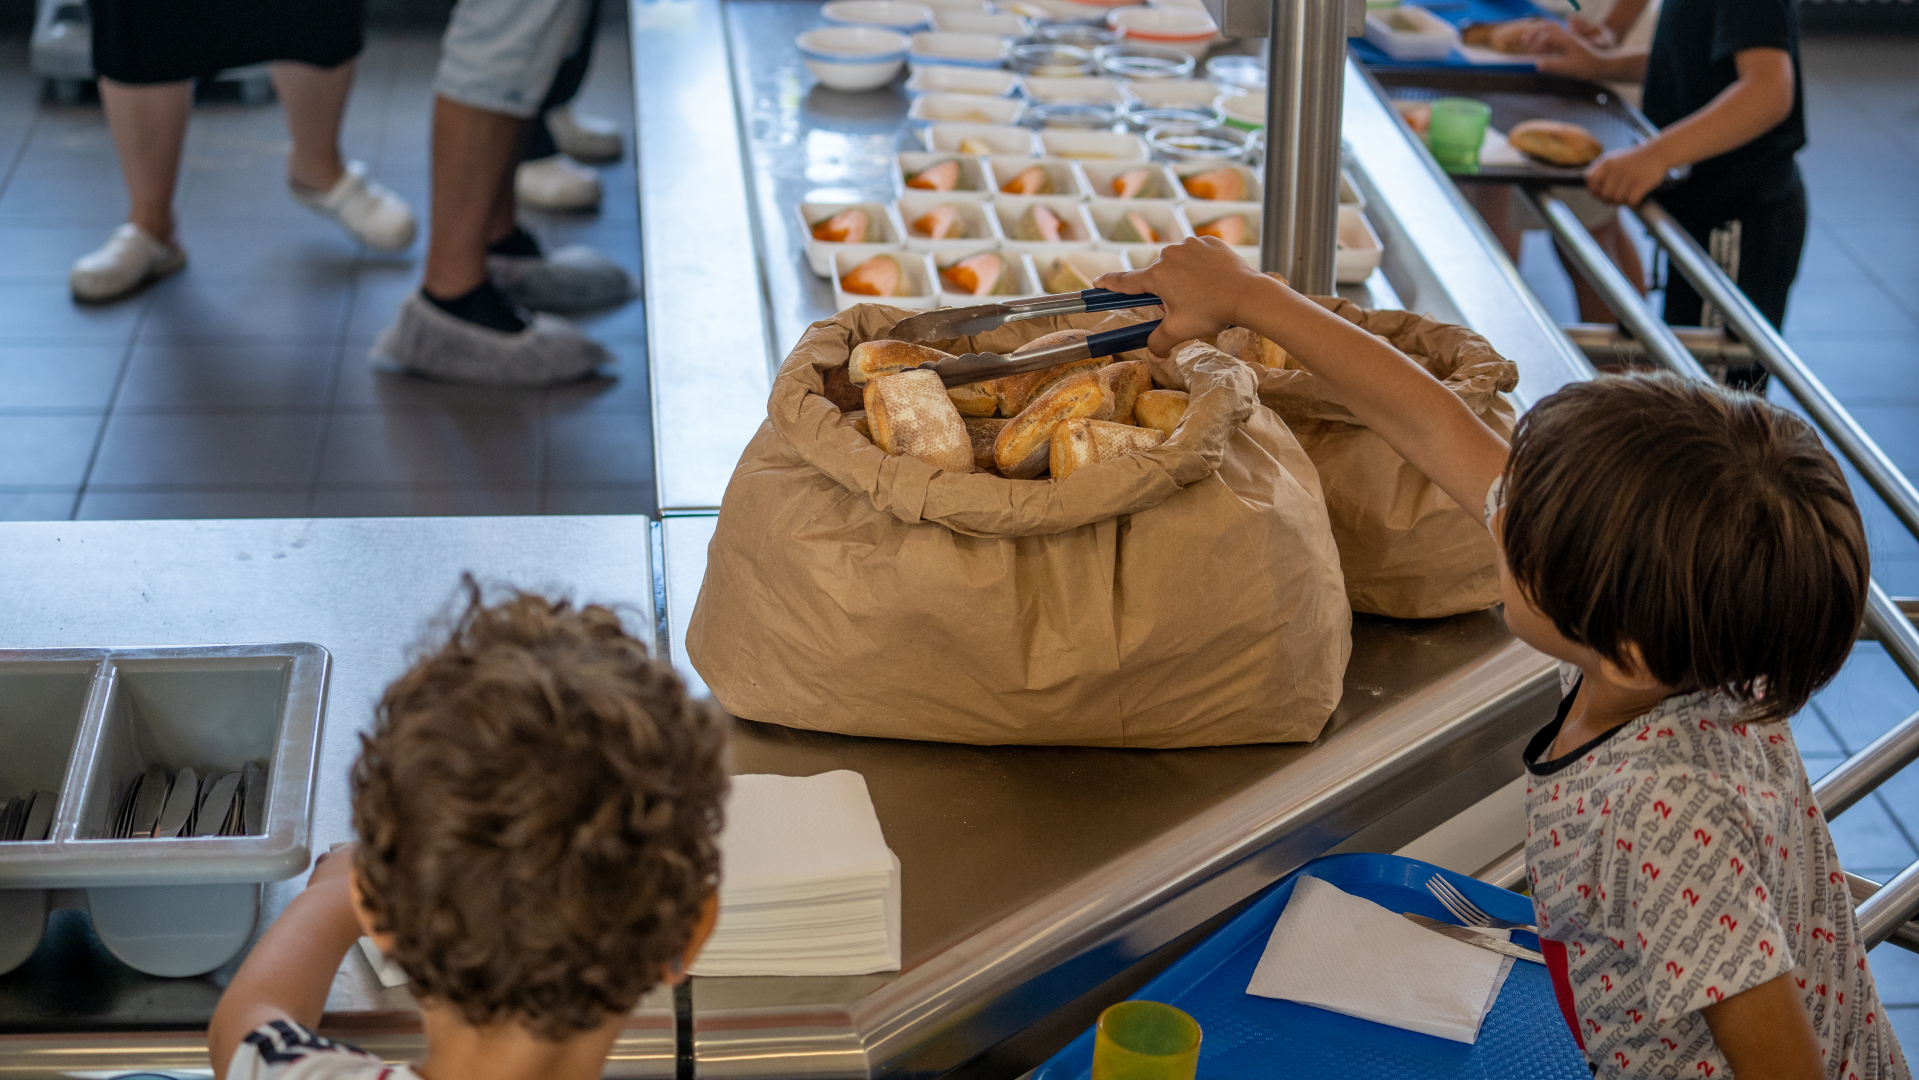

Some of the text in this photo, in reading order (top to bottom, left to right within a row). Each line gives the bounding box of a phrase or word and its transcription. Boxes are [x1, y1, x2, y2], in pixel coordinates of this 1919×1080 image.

[1641, 828, 1712, 931] Dsquared-2
[1675, 856, 1745, 957] Dsquared-2
[1666, 914, 1738, 1014] Dsquared-2
